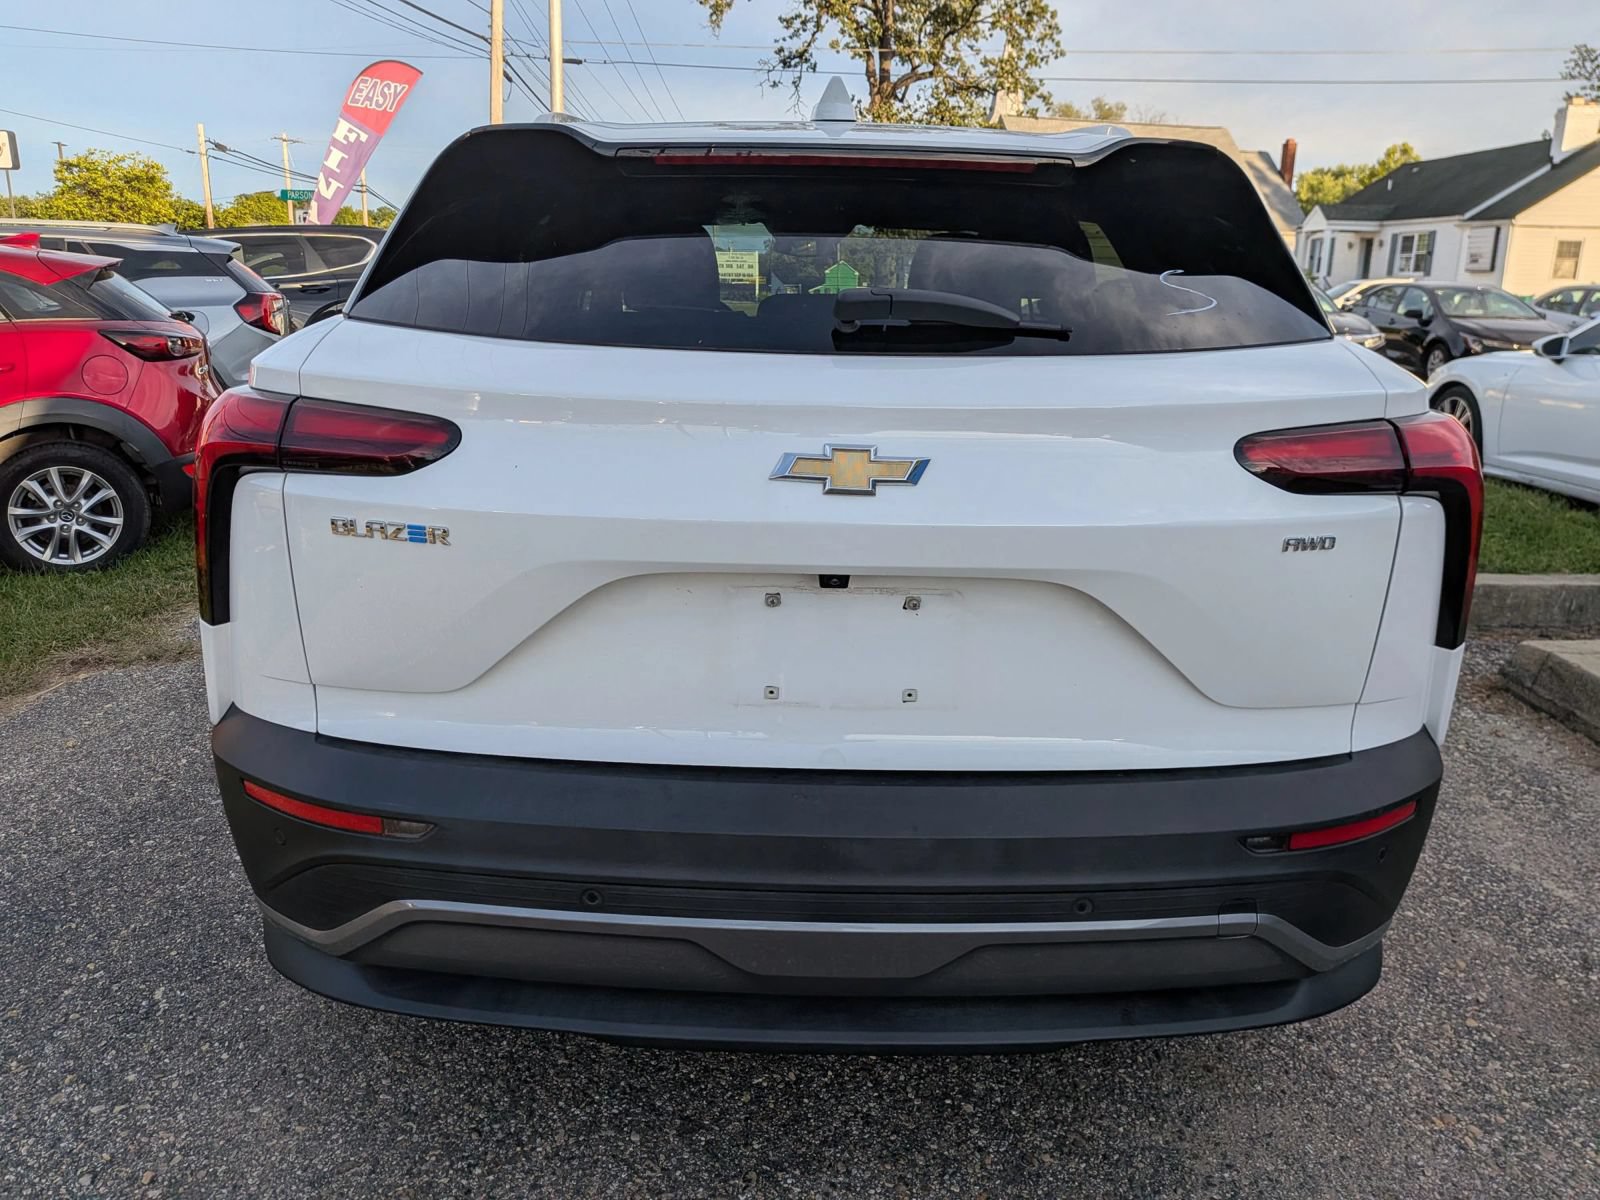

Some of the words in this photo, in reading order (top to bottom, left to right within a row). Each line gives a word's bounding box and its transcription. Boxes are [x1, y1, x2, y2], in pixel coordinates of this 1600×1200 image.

[348, 76, 408, 112] EASY
[330, 516, 451, 546] BLAZER
[1281, 535, 1337, 552] AWD
